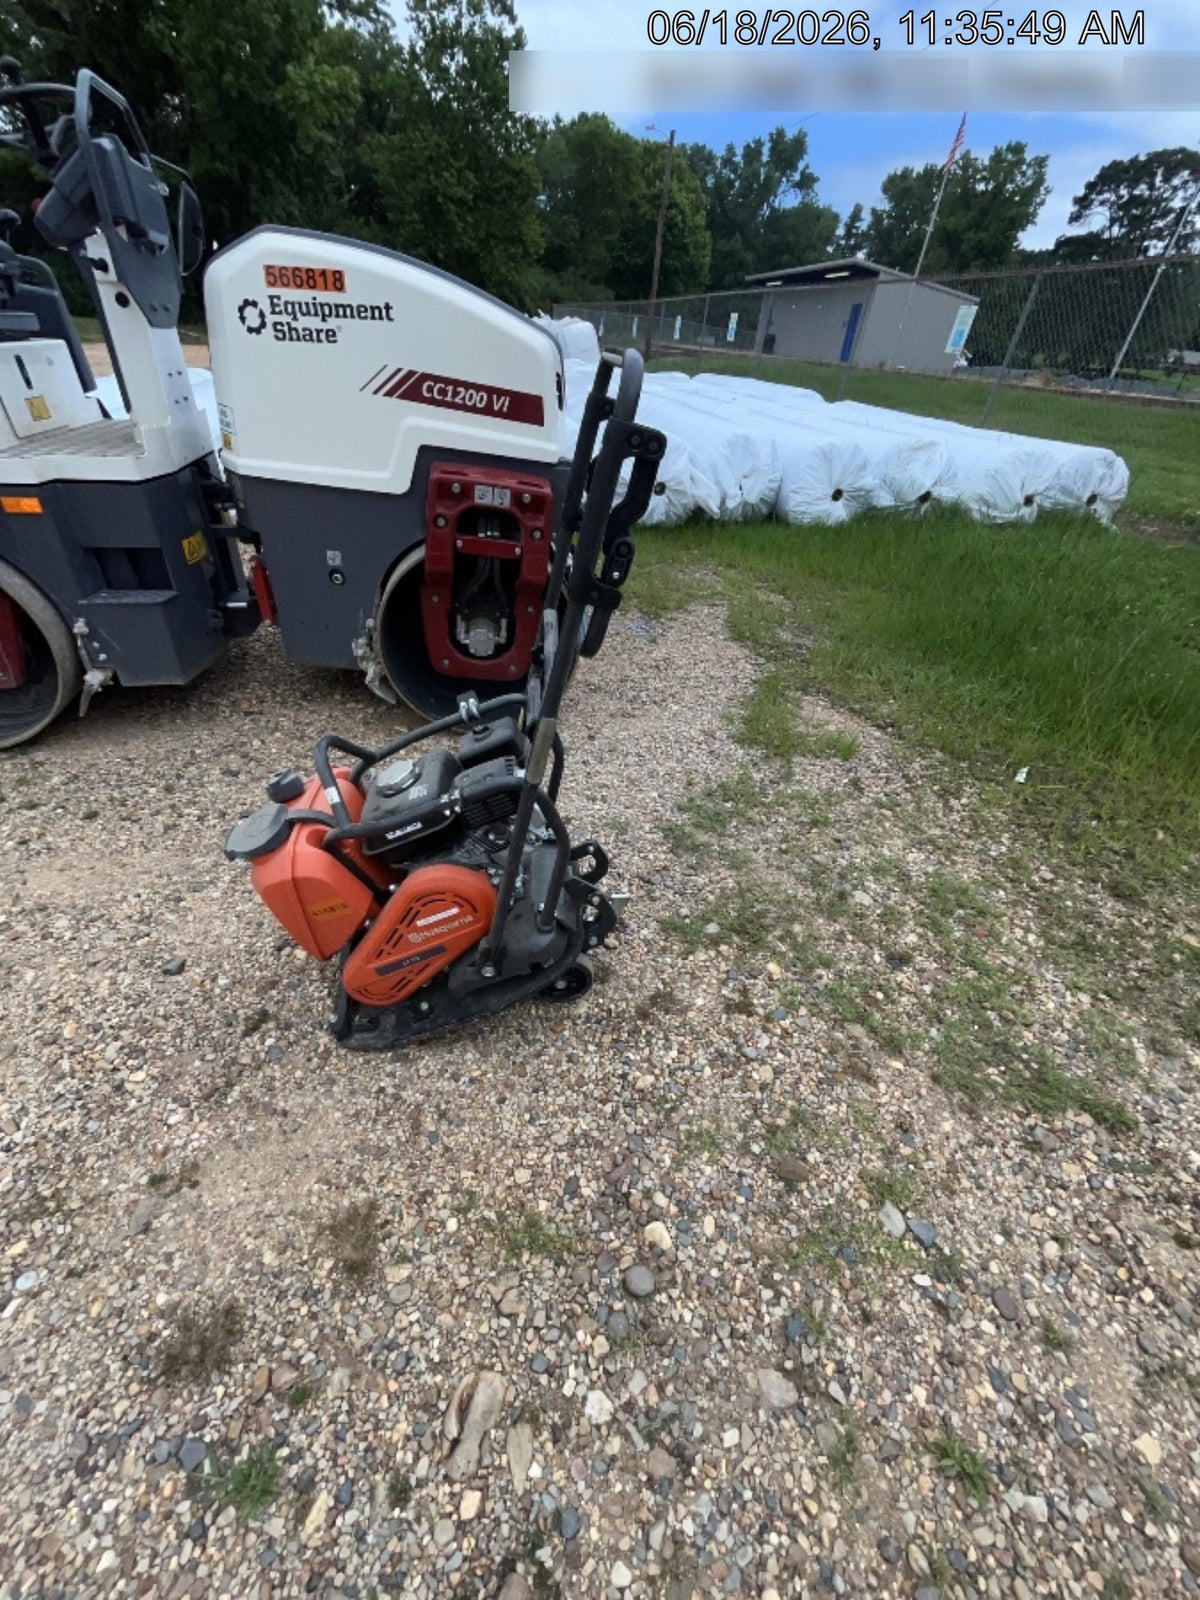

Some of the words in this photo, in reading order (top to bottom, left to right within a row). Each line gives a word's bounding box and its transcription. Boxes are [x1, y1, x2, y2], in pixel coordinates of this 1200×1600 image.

[264, 265, 345, 292] 566818
[267, 294, 395, 323] Equipment
[272, 320, 338, 344] Share
[421, 380, 488, 409] CC1200
[492, 393, 511, 413] VI
